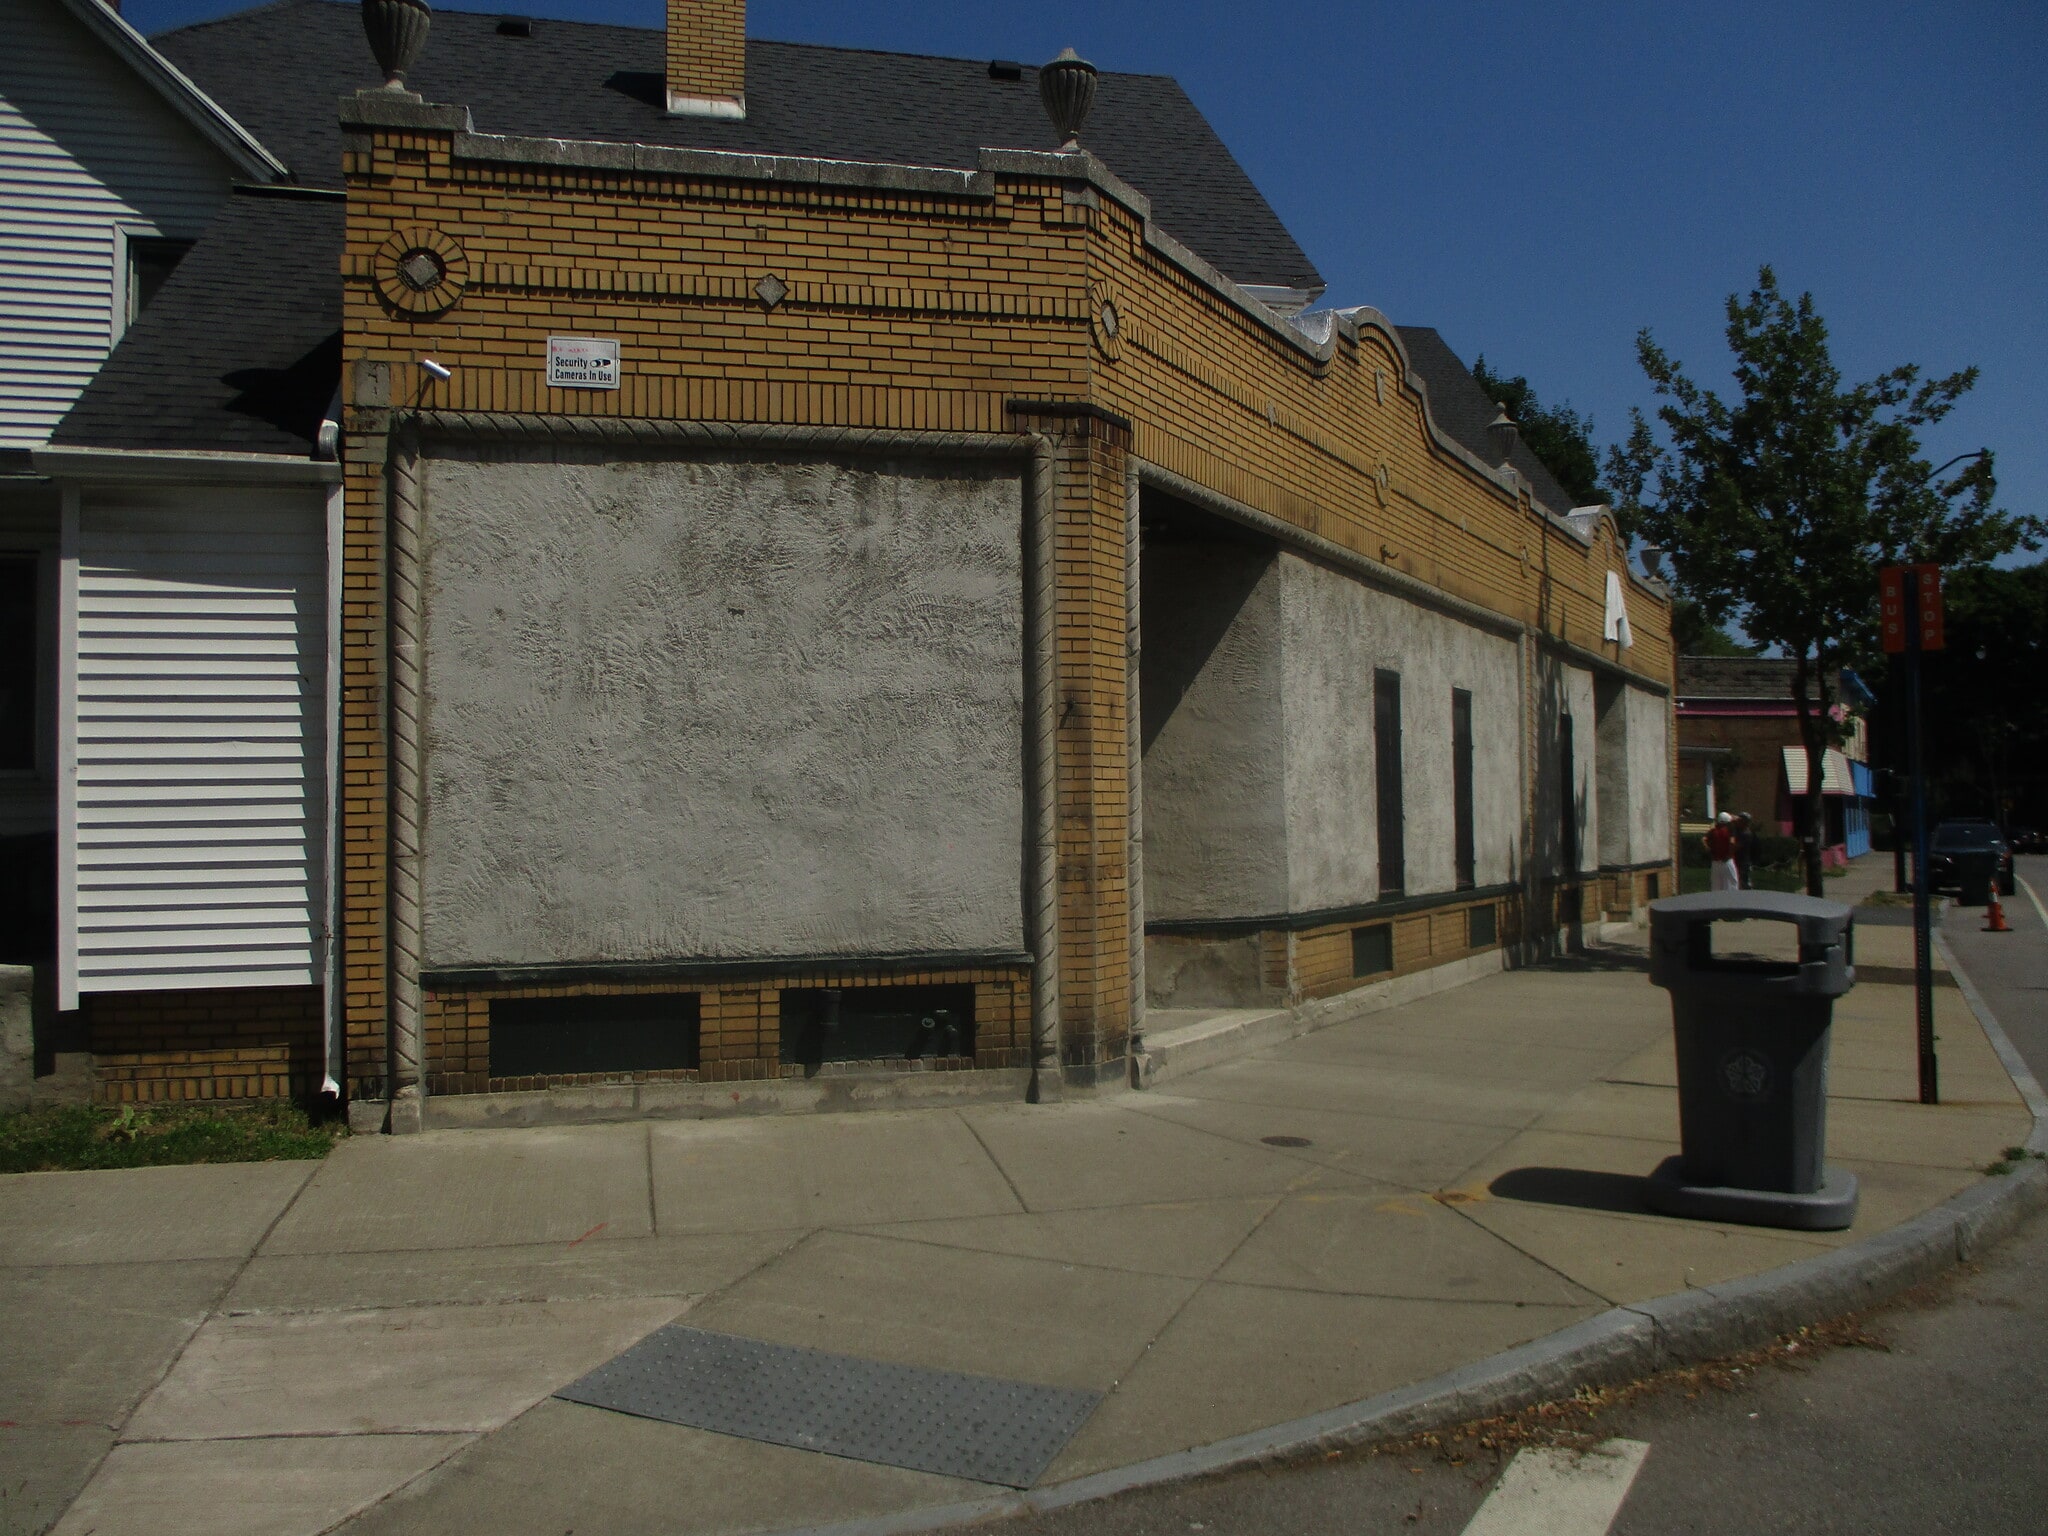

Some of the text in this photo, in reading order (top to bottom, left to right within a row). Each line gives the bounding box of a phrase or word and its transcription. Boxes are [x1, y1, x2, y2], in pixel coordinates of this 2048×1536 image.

[555, 356, 588, 369] Security
[555, 369, 612, 381] Cameras In Use
[1886, 586, 1898, 634] BUS
[1922, 573, 1936, 640] STOP
